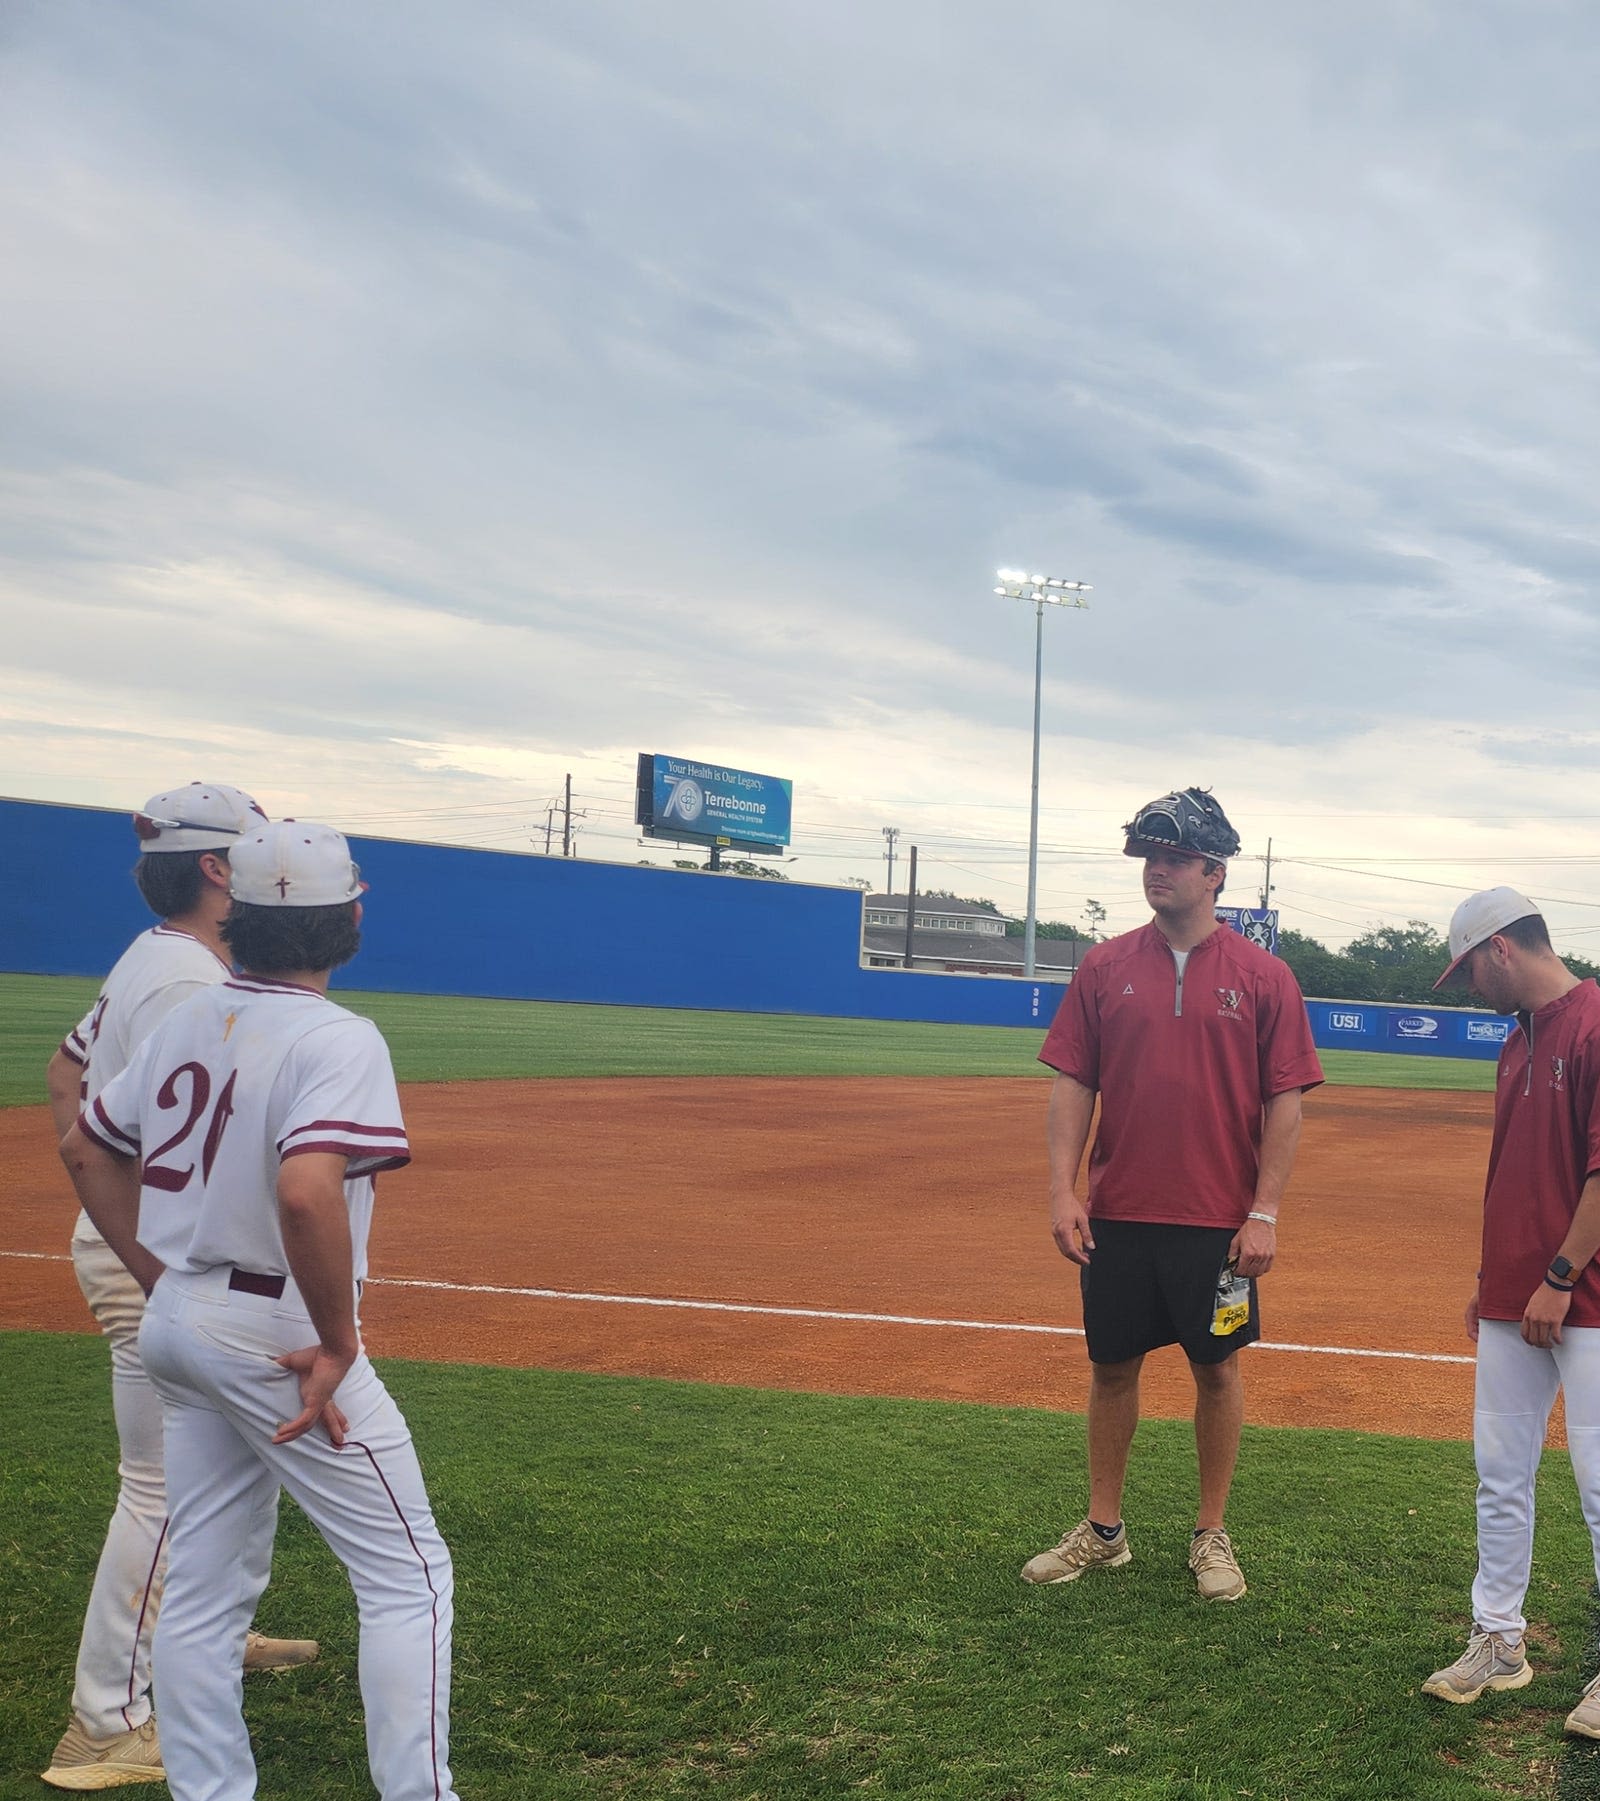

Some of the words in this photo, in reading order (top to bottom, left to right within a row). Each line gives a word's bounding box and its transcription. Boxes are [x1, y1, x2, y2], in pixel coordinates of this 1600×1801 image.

[668, 760, 686, 774] Your
[688, 764, 713, 780] Health
[714, 768, 721, 781] is
[722, 771, 737, 784] Our
[738, 774, 765, 791] Legacy.
[663, 774, 703, 821] 70
[704, 791, 767, 814] Terrebonne
[1332, 1014, 1360, 1029] USI
